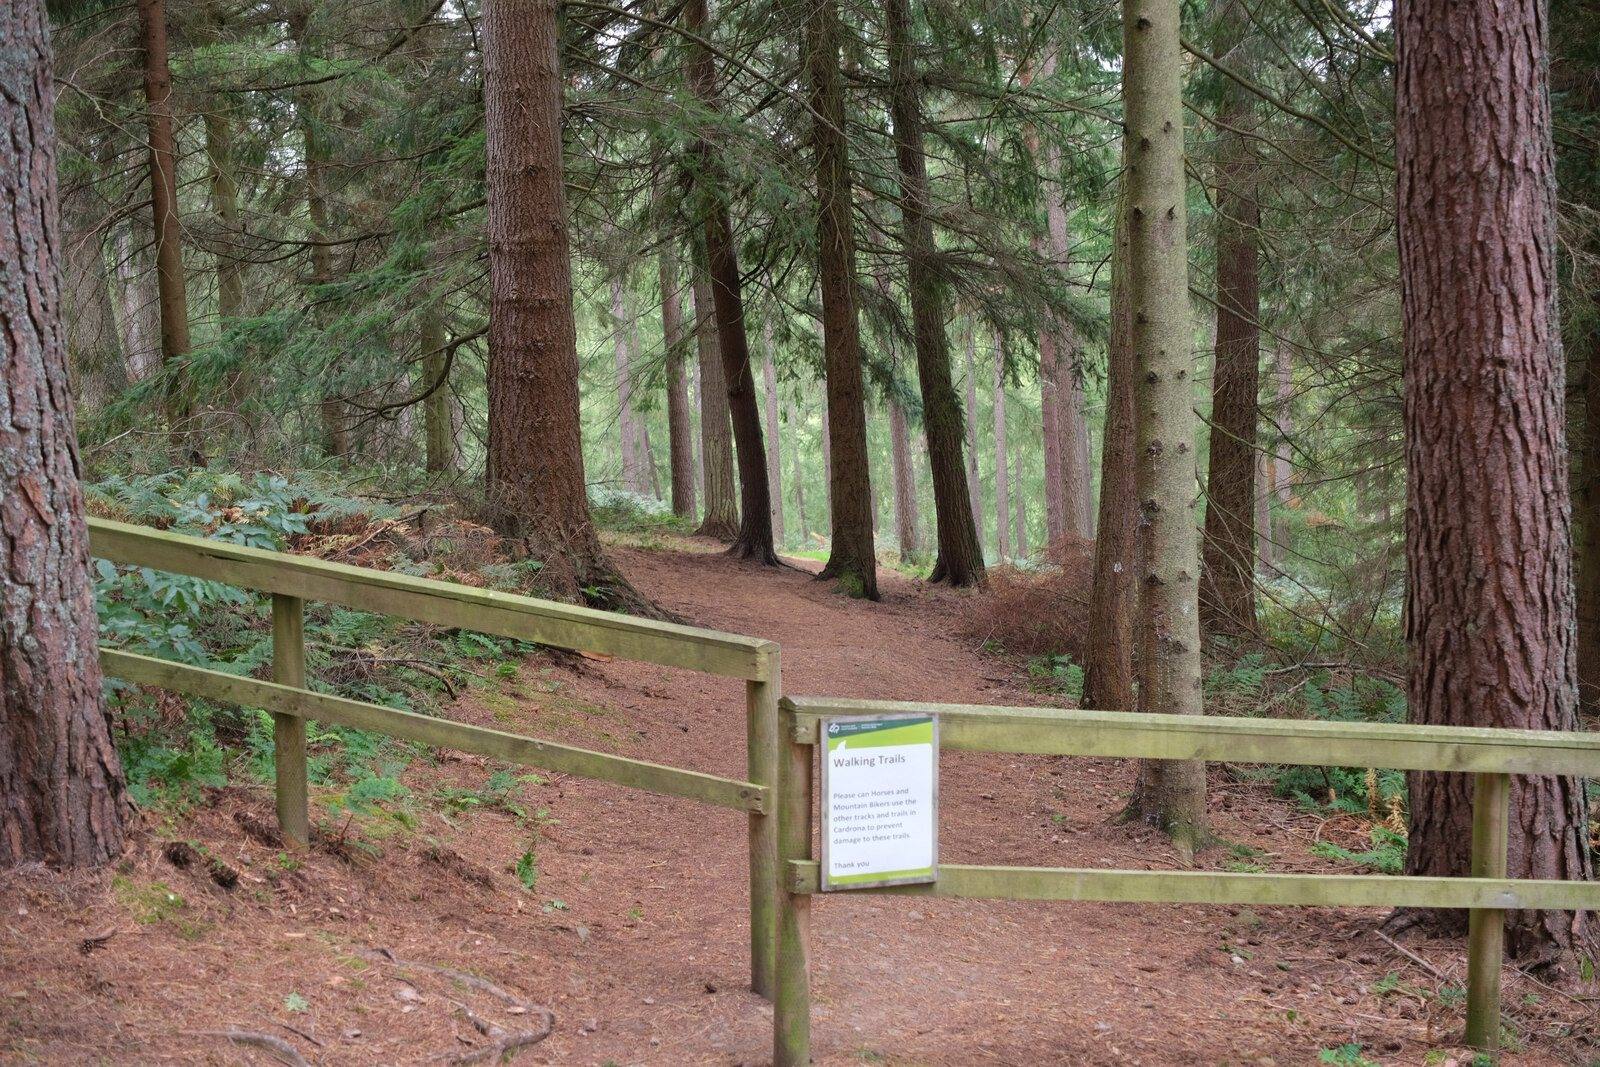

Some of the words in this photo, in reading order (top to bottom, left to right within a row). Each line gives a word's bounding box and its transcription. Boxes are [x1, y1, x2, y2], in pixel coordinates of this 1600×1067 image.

[834, 756, 876, 768] Walking
[878, 754, 906, 764] Trails
[834, 802, 868, 810] Mountain
[834, 825, 866, 833] Cardrona
[876, 822, 903, 832] prevent
[833, 837, 862, 845] damage
